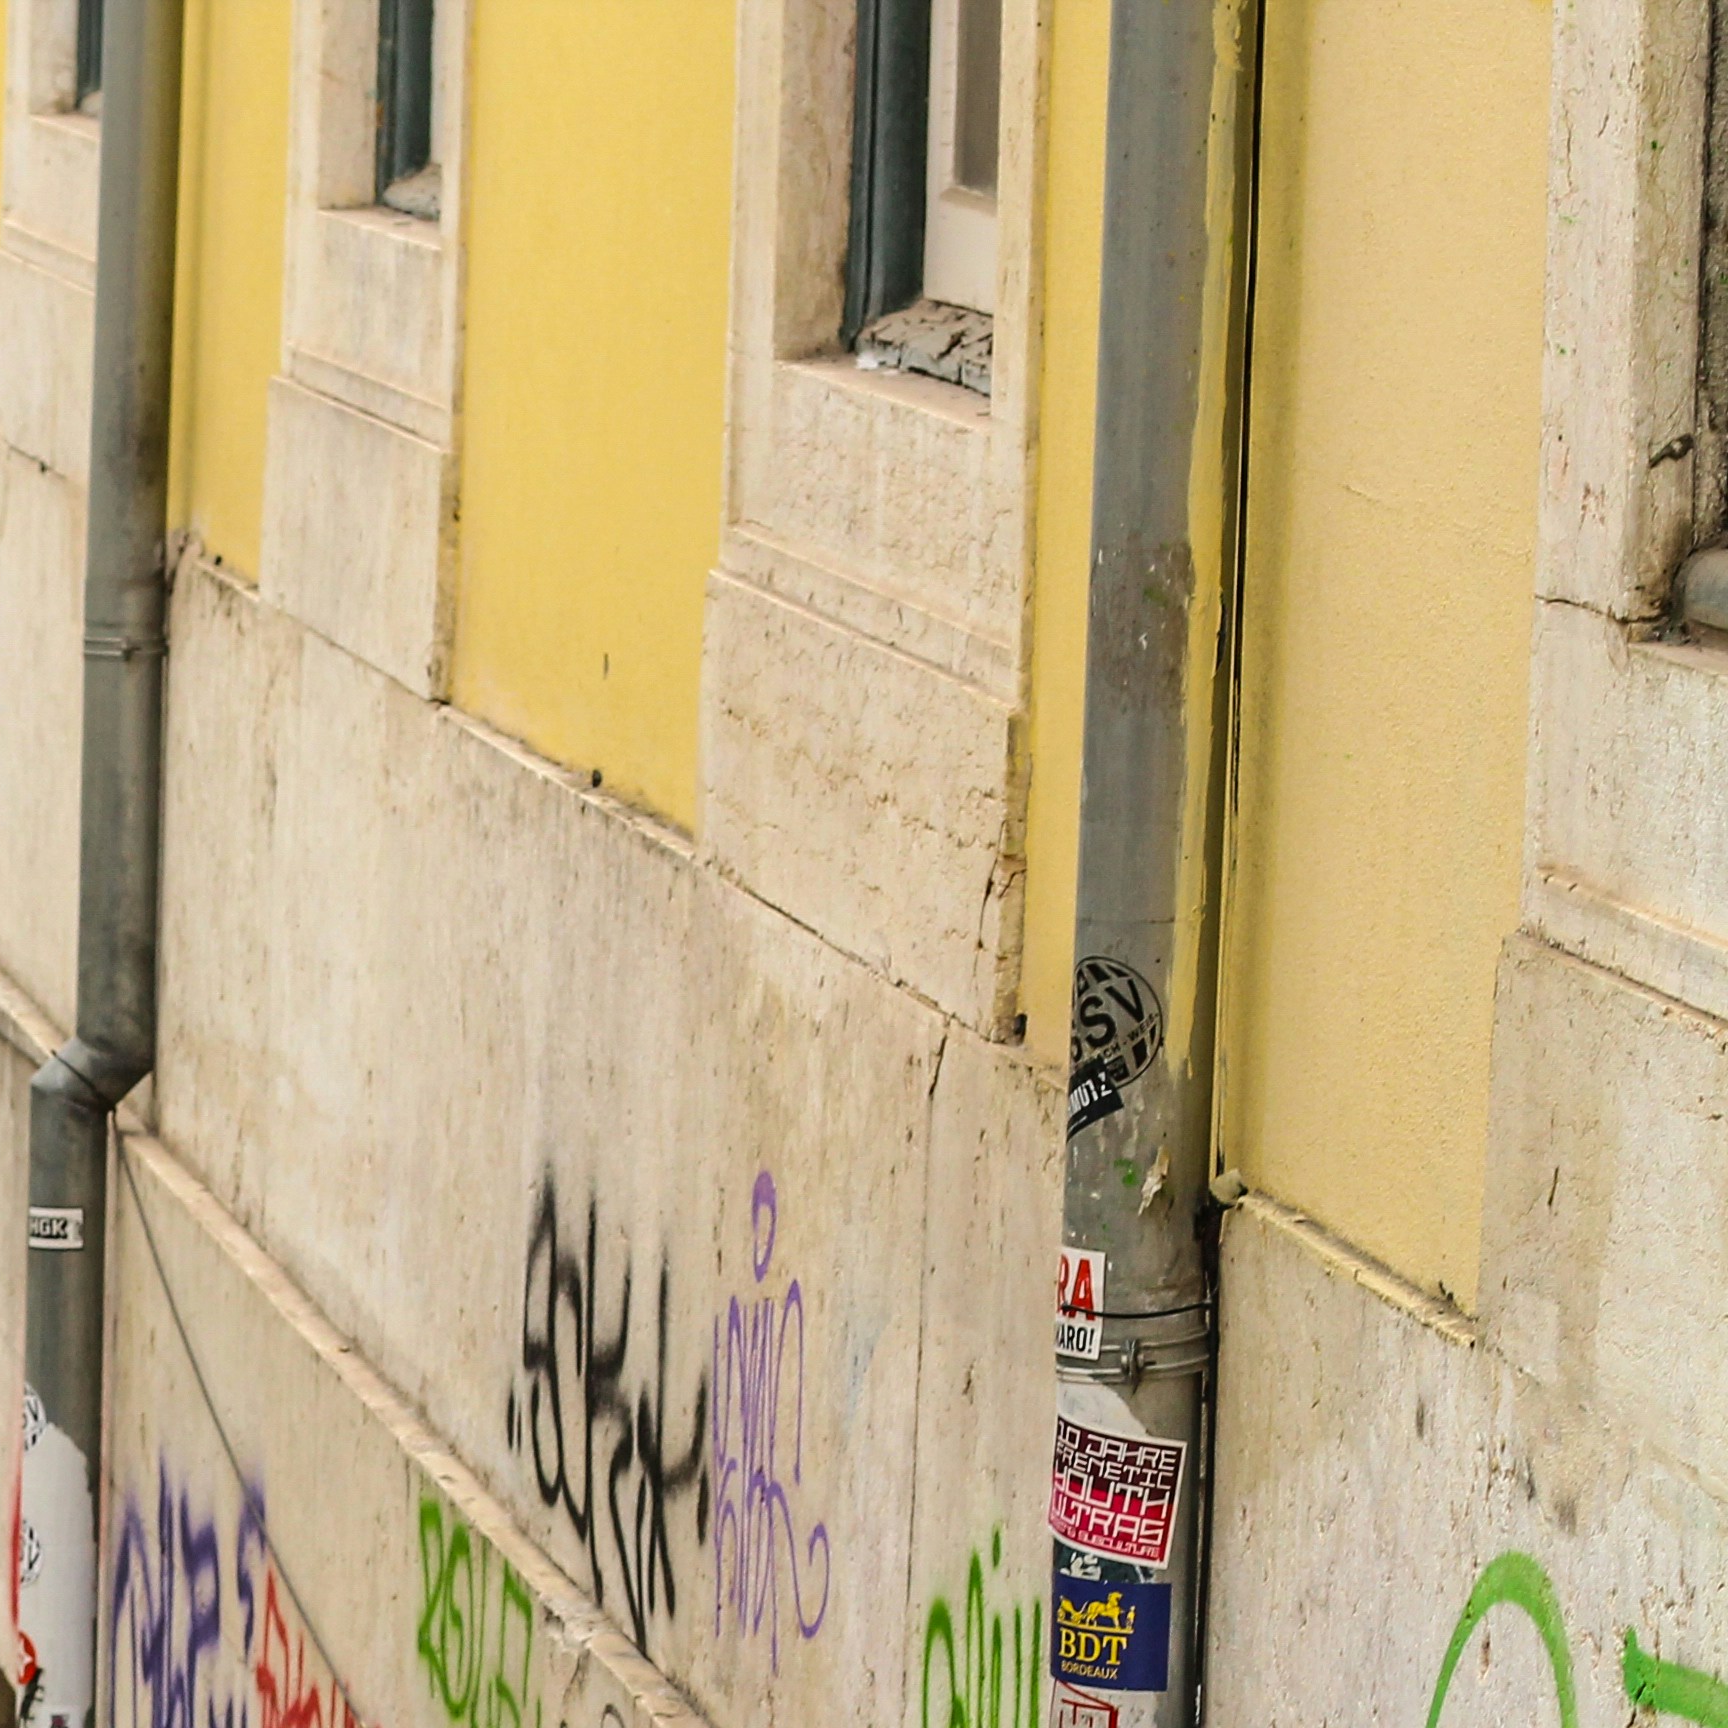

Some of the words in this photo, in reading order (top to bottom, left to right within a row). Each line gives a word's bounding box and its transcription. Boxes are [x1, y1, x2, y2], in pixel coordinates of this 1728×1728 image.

[1056, 1442, 1174, 1490] FRENETIC
[1058, 1421, 1081, 1450] 10
[1085, 1434, 1177, 1471] JAHRE
[1055, 1460, 1170, 1519] YOUTH
[1052, 1488, 1166, 1546] ULTRAS
[1058, 1609, 1128, 1666] BDT
[1060, 1660, 1119, 1681] BORDEAUX
